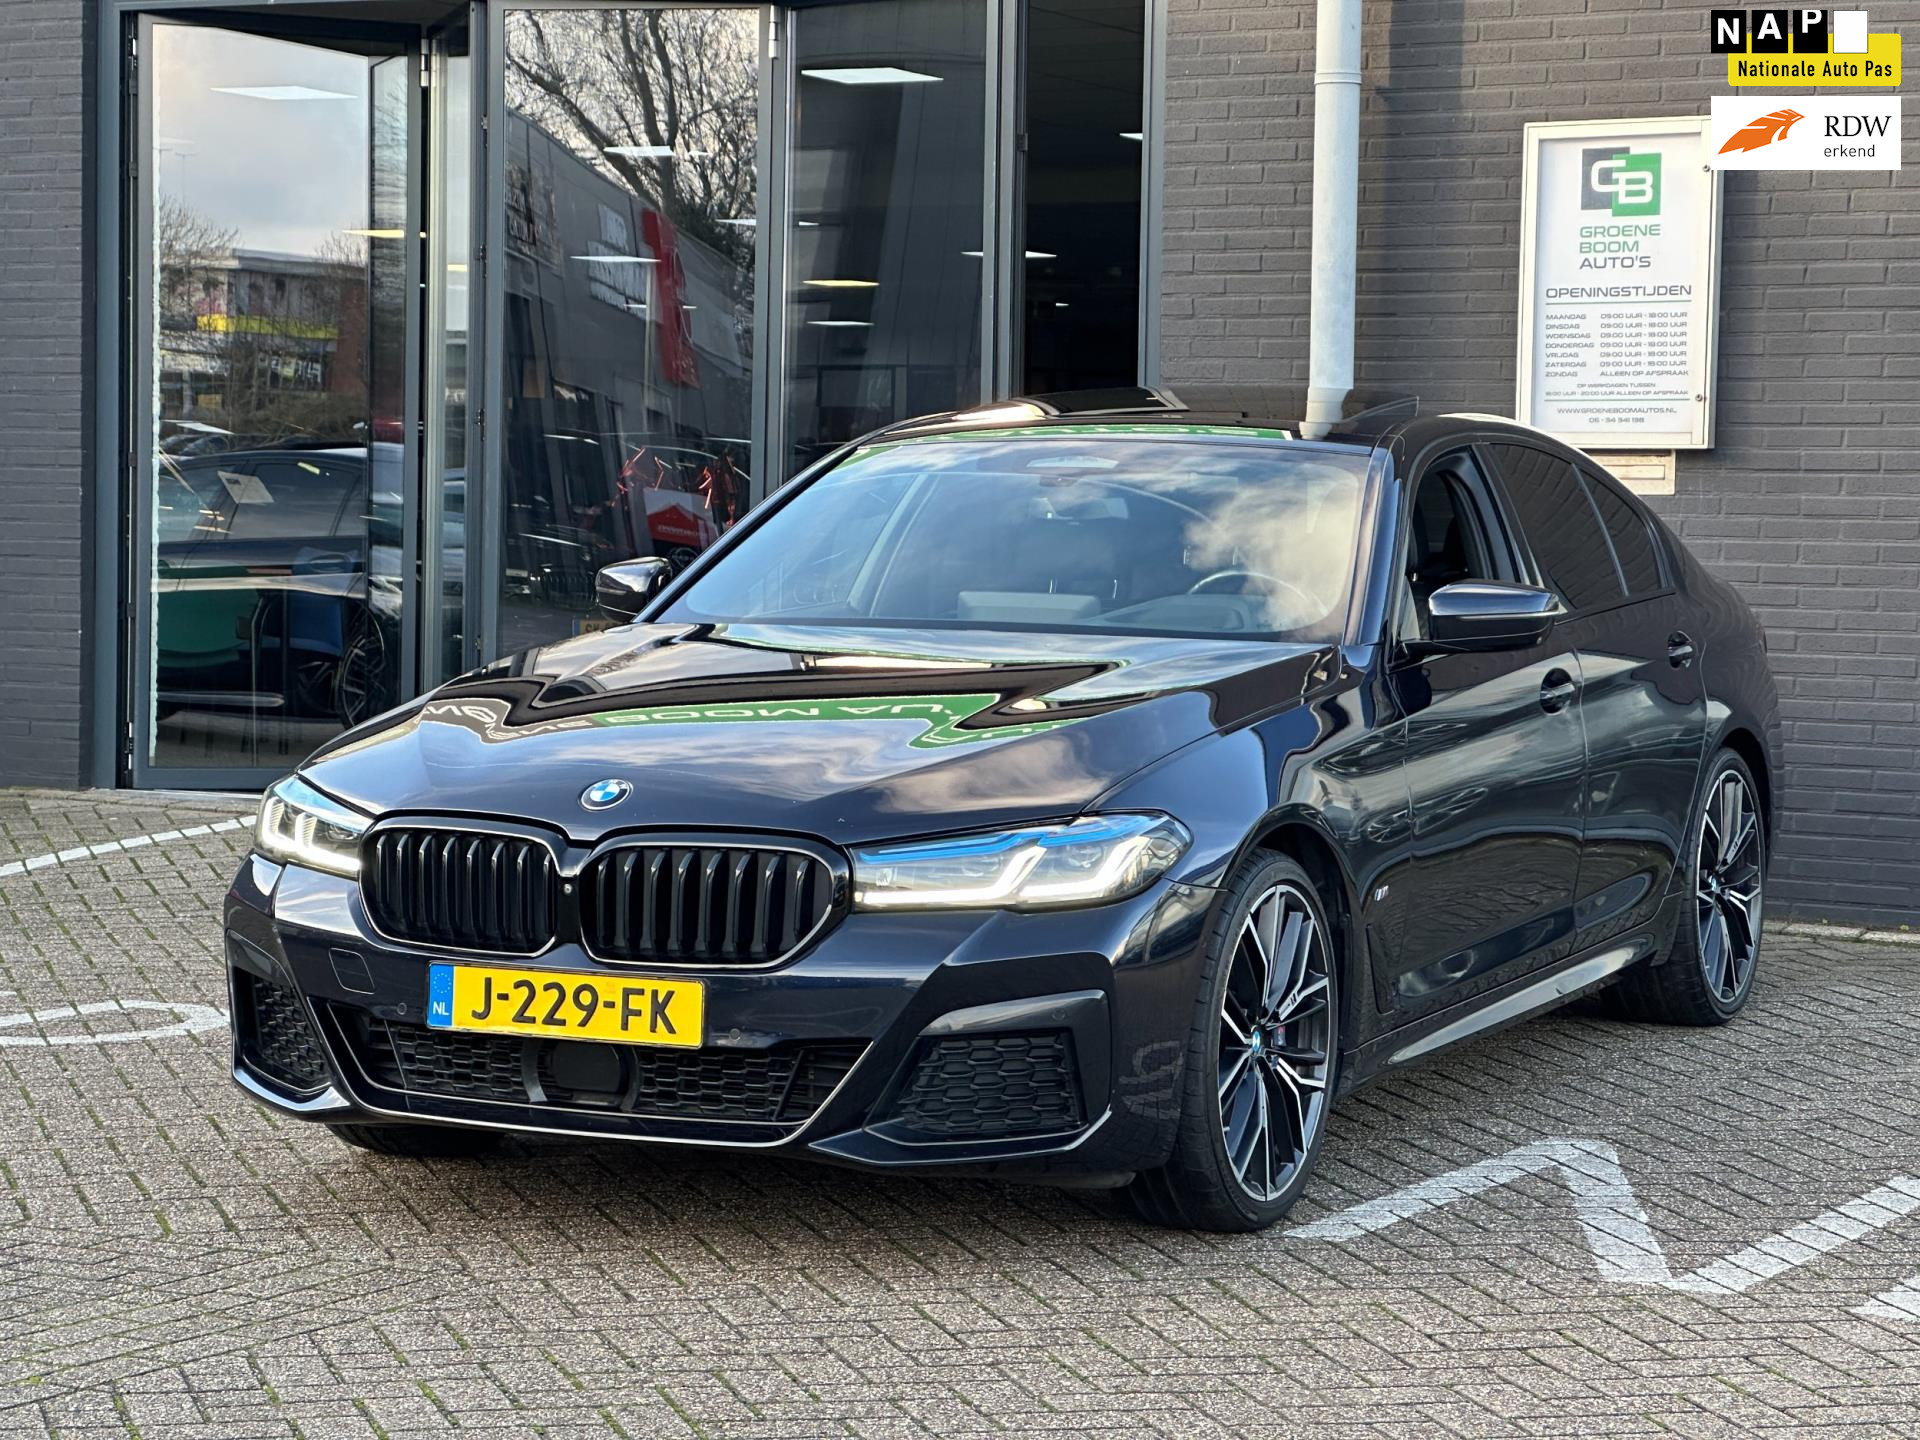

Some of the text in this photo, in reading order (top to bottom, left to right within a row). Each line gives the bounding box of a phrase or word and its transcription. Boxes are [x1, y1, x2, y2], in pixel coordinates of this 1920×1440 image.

[1579, 223, 1661, 238] GROENE
[1579, 240, 1639, 254] BOOM
[1579, 256, 1651, 270] AUTO'S
[1545, 285, 1692, 299] OPENINGSTIJDEN
[433, 976, 677, 1035] NL J-229-FK
